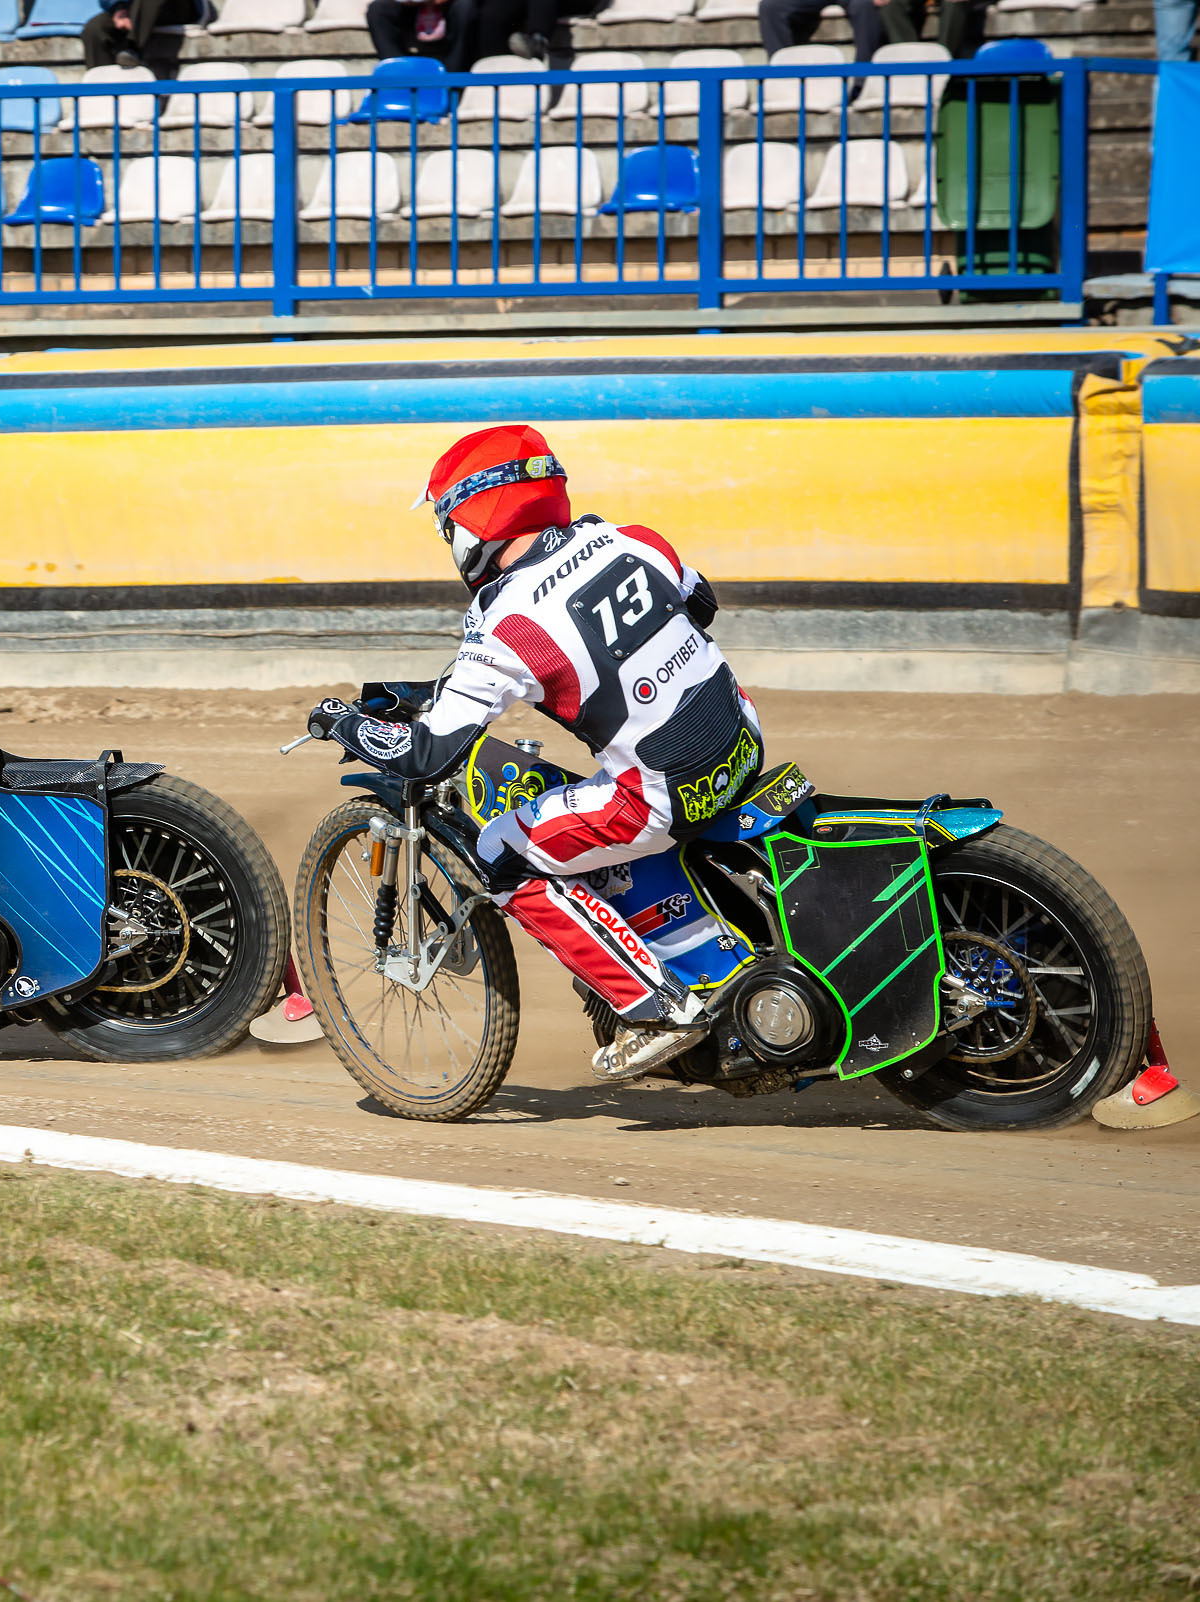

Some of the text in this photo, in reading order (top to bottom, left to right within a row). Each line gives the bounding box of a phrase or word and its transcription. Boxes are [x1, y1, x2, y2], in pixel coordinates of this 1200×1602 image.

[591, 565, 653, 647] 13
[656, 633, 699, 684] OPTIBET
[656, 894, 691, 923] K&N
